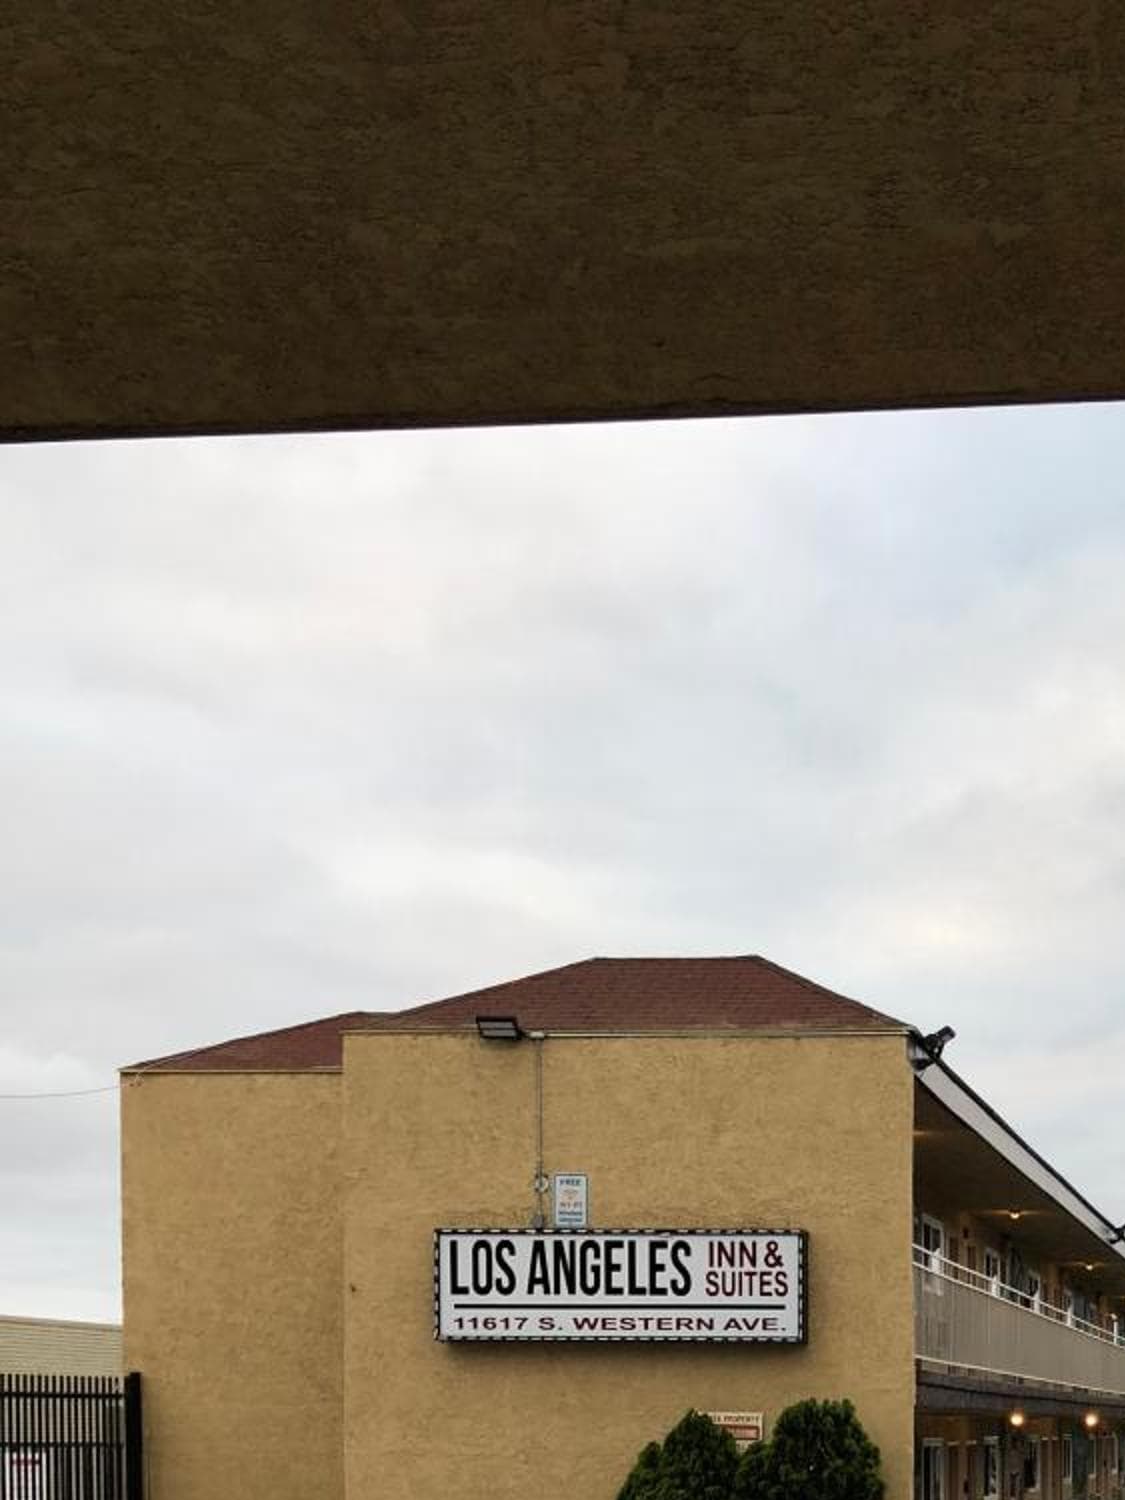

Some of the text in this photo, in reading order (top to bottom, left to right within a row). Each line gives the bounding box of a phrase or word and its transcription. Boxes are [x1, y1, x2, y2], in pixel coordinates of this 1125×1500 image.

[708, 1240, 784, 1268] INN &
[449, 1239, 692, 1297] LOS ANGELES
[705, 1271, 789, 1297] SUITES
[453, 1317, 786, 1332] 11617 S. WESTERN AVE.
